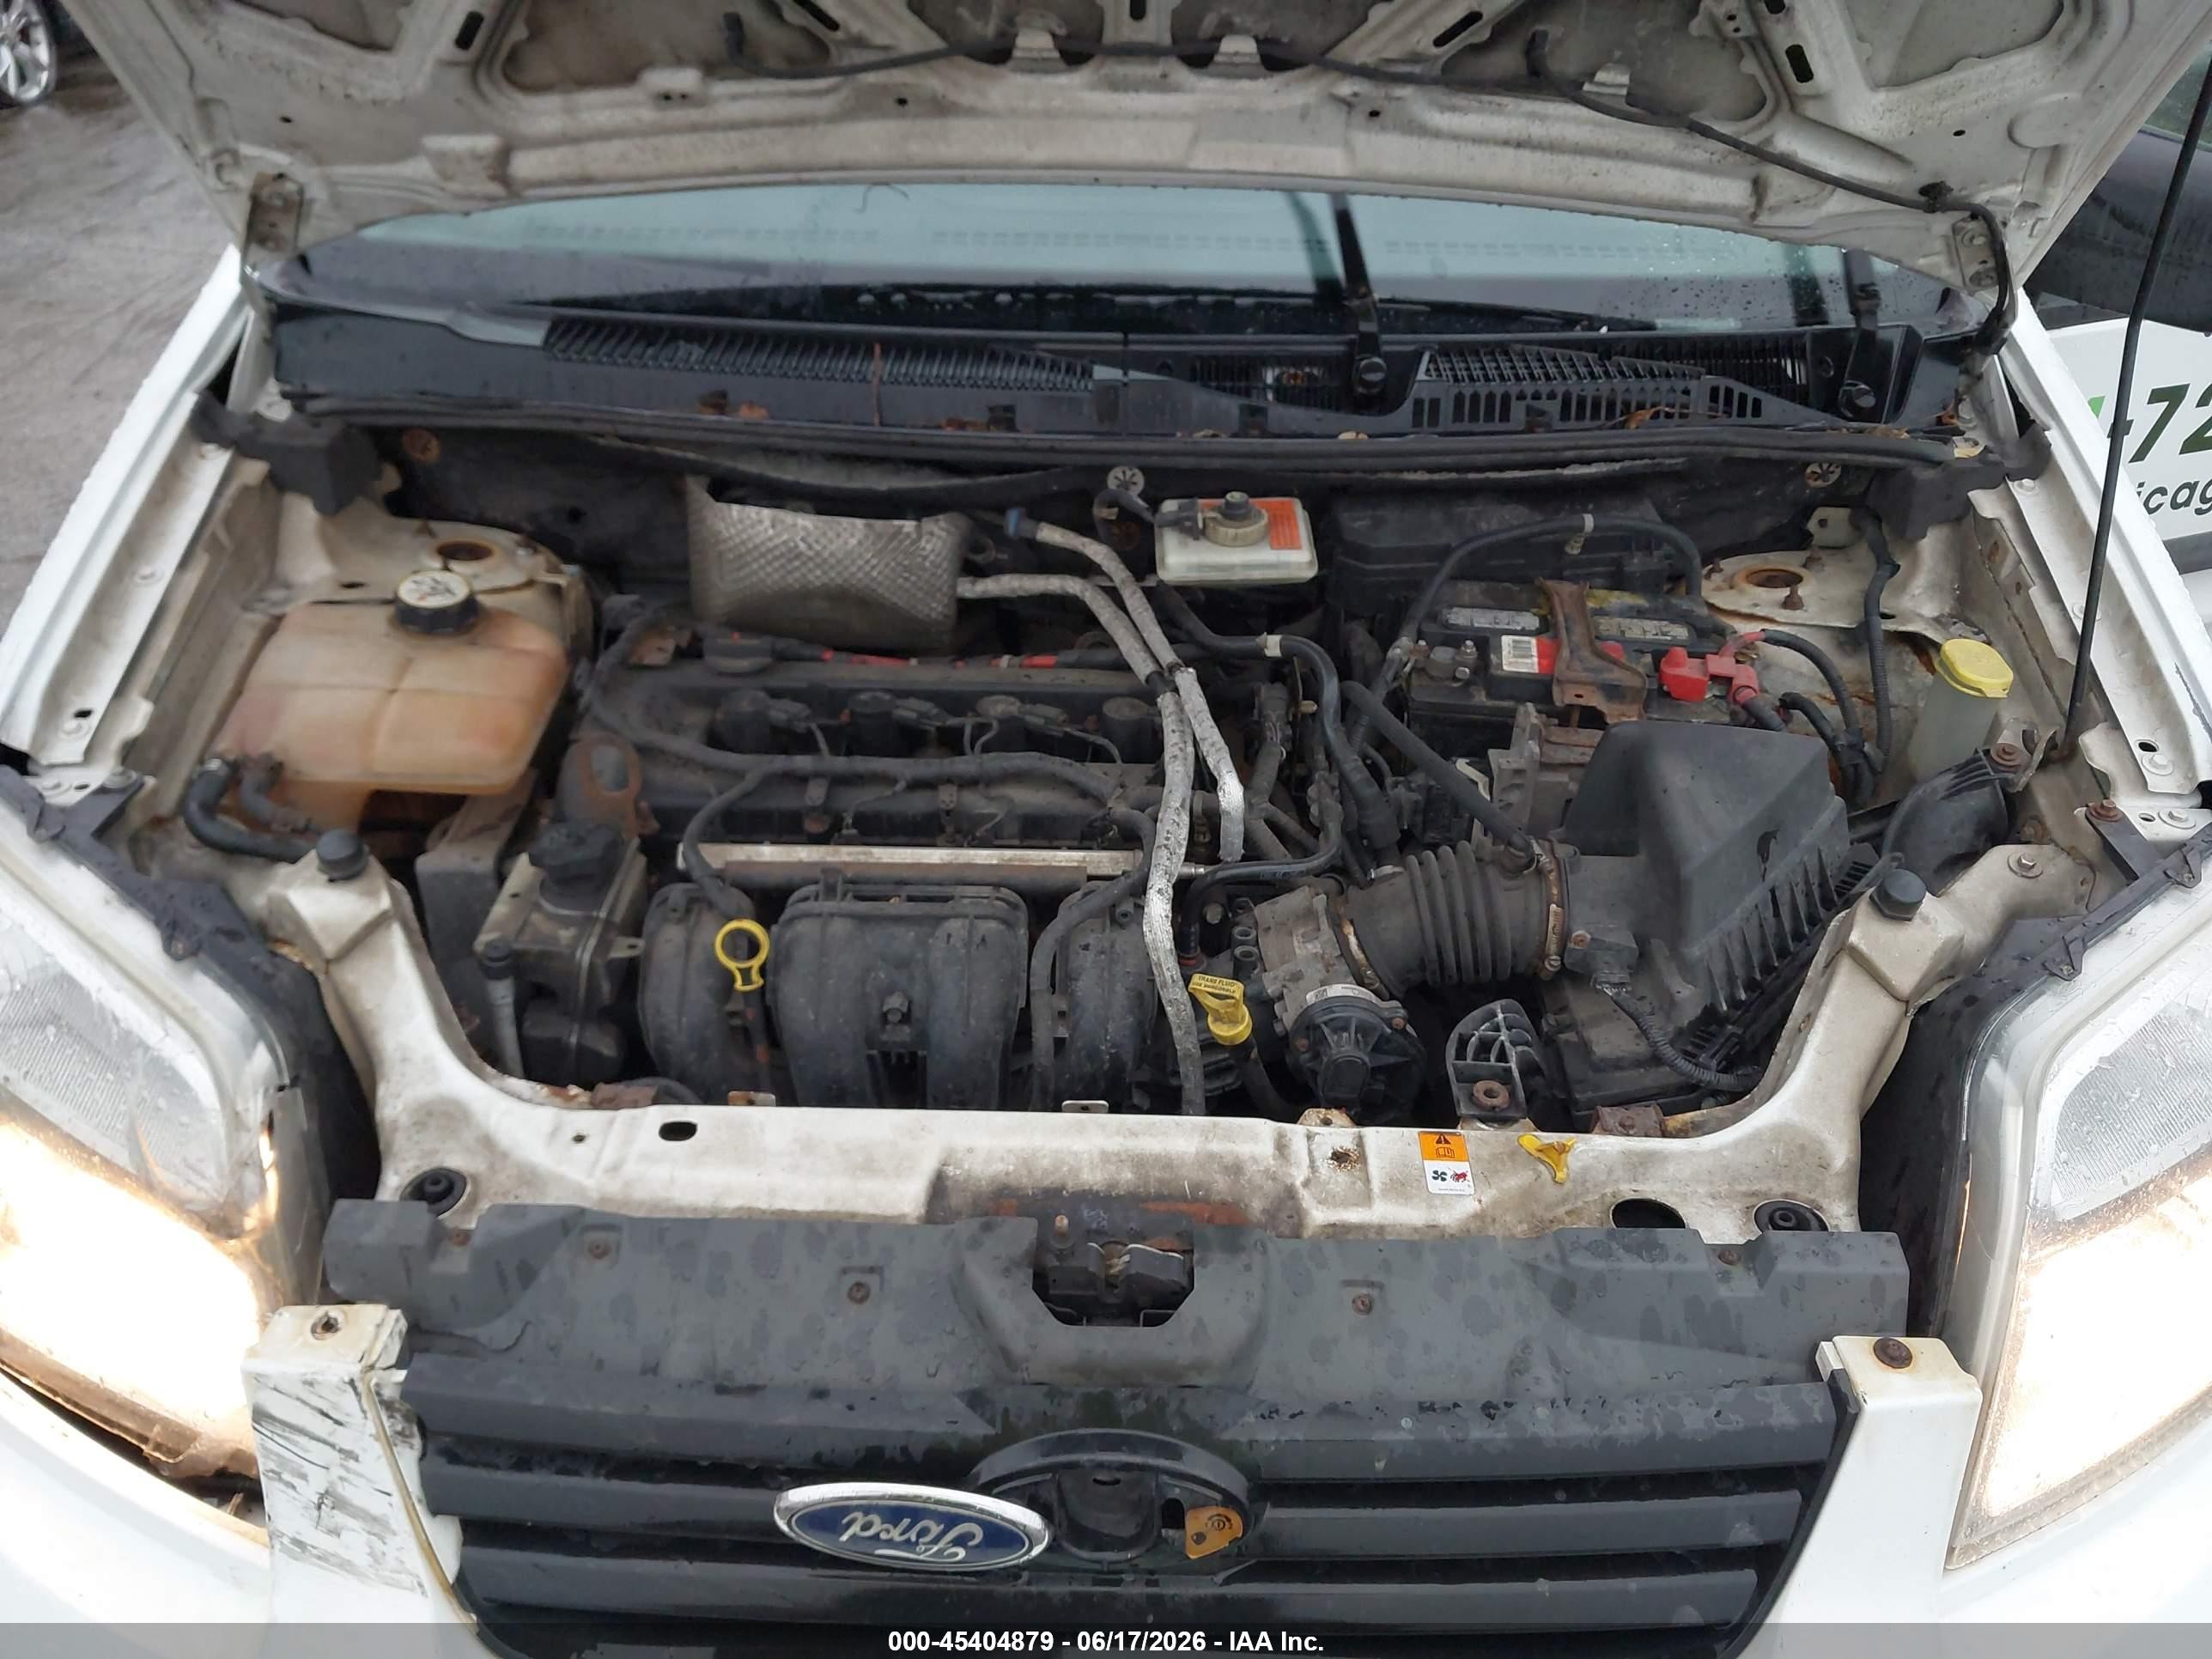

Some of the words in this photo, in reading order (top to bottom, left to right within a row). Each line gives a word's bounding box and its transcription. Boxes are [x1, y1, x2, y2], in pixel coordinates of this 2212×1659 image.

[1198, 975, 1218, 984] TRANS
[1218, 979, 1236, 988] FLUID
[839, 1510, 985, 1563] Ford
